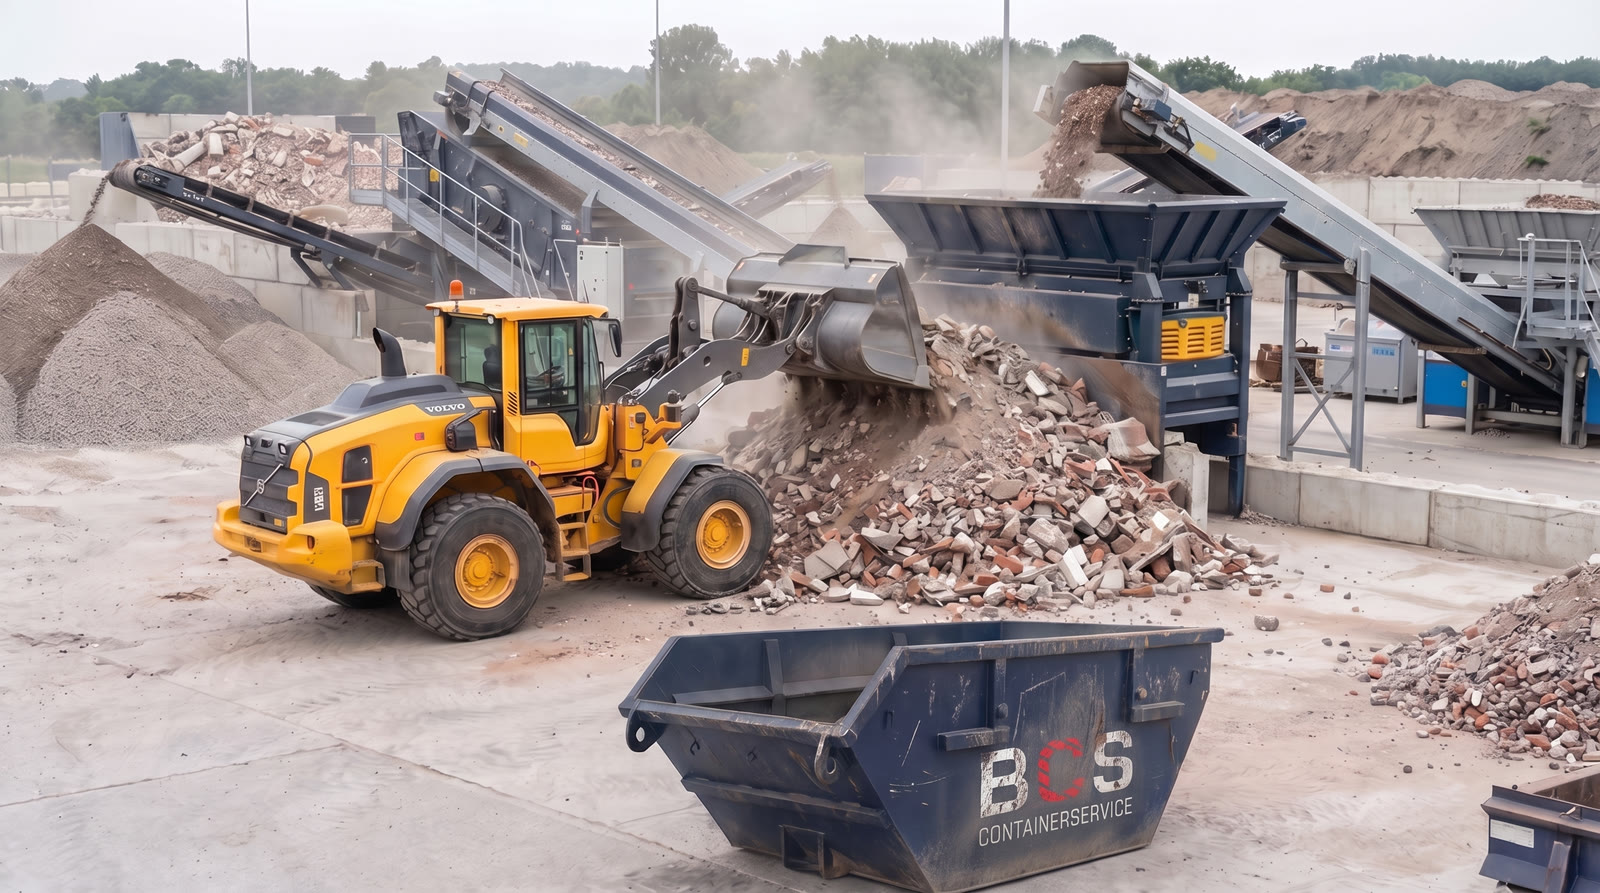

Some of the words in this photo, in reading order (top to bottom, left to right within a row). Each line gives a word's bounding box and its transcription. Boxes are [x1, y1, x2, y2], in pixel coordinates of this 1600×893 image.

[425, 403, 466, 413] VOLVO
[980, 730, 1133, 819] BCS
[978, 797, 1133, 847] CONTAINERSERVICE
